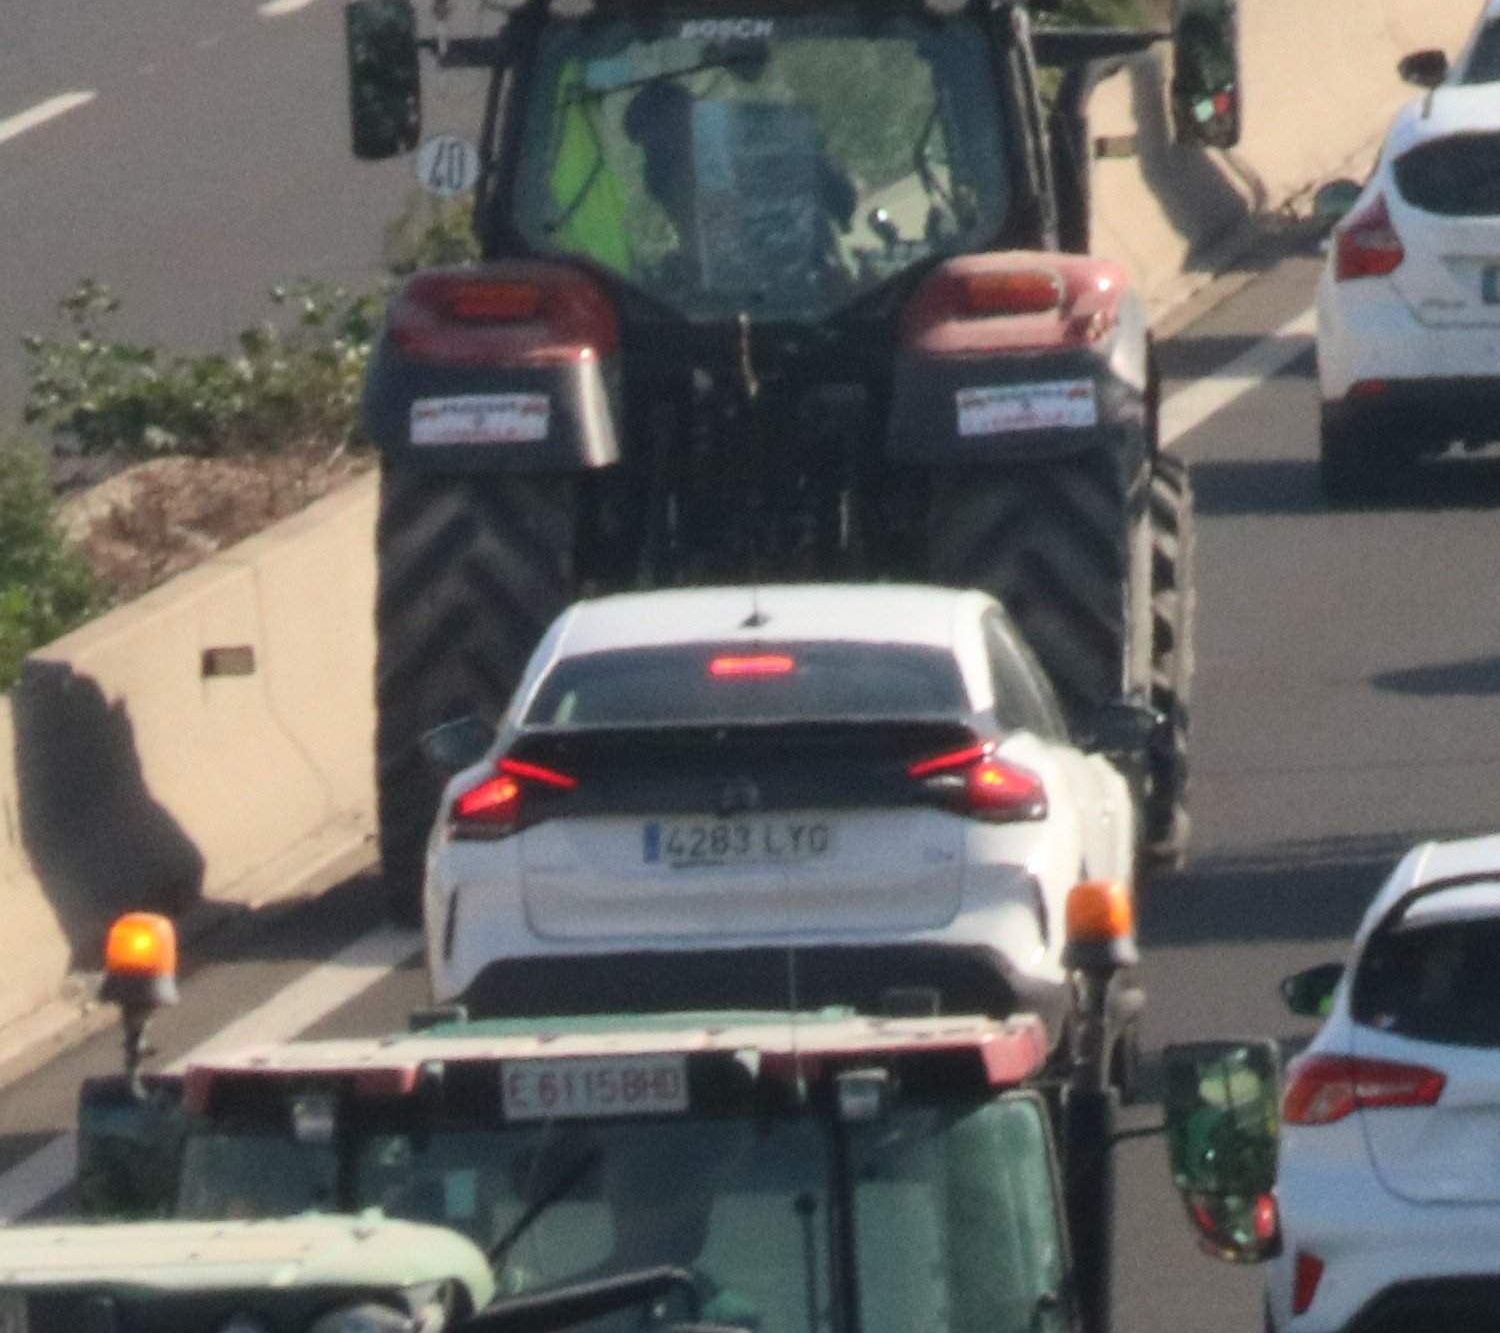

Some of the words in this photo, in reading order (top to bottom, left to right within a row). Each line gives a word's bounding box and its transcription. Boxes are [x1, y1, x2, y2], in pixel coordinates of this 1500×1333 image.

[679, 17, 775, 39] BOSCH
[429, 151, 467, 193] 40
[665, 823, 751, 858] 4283
